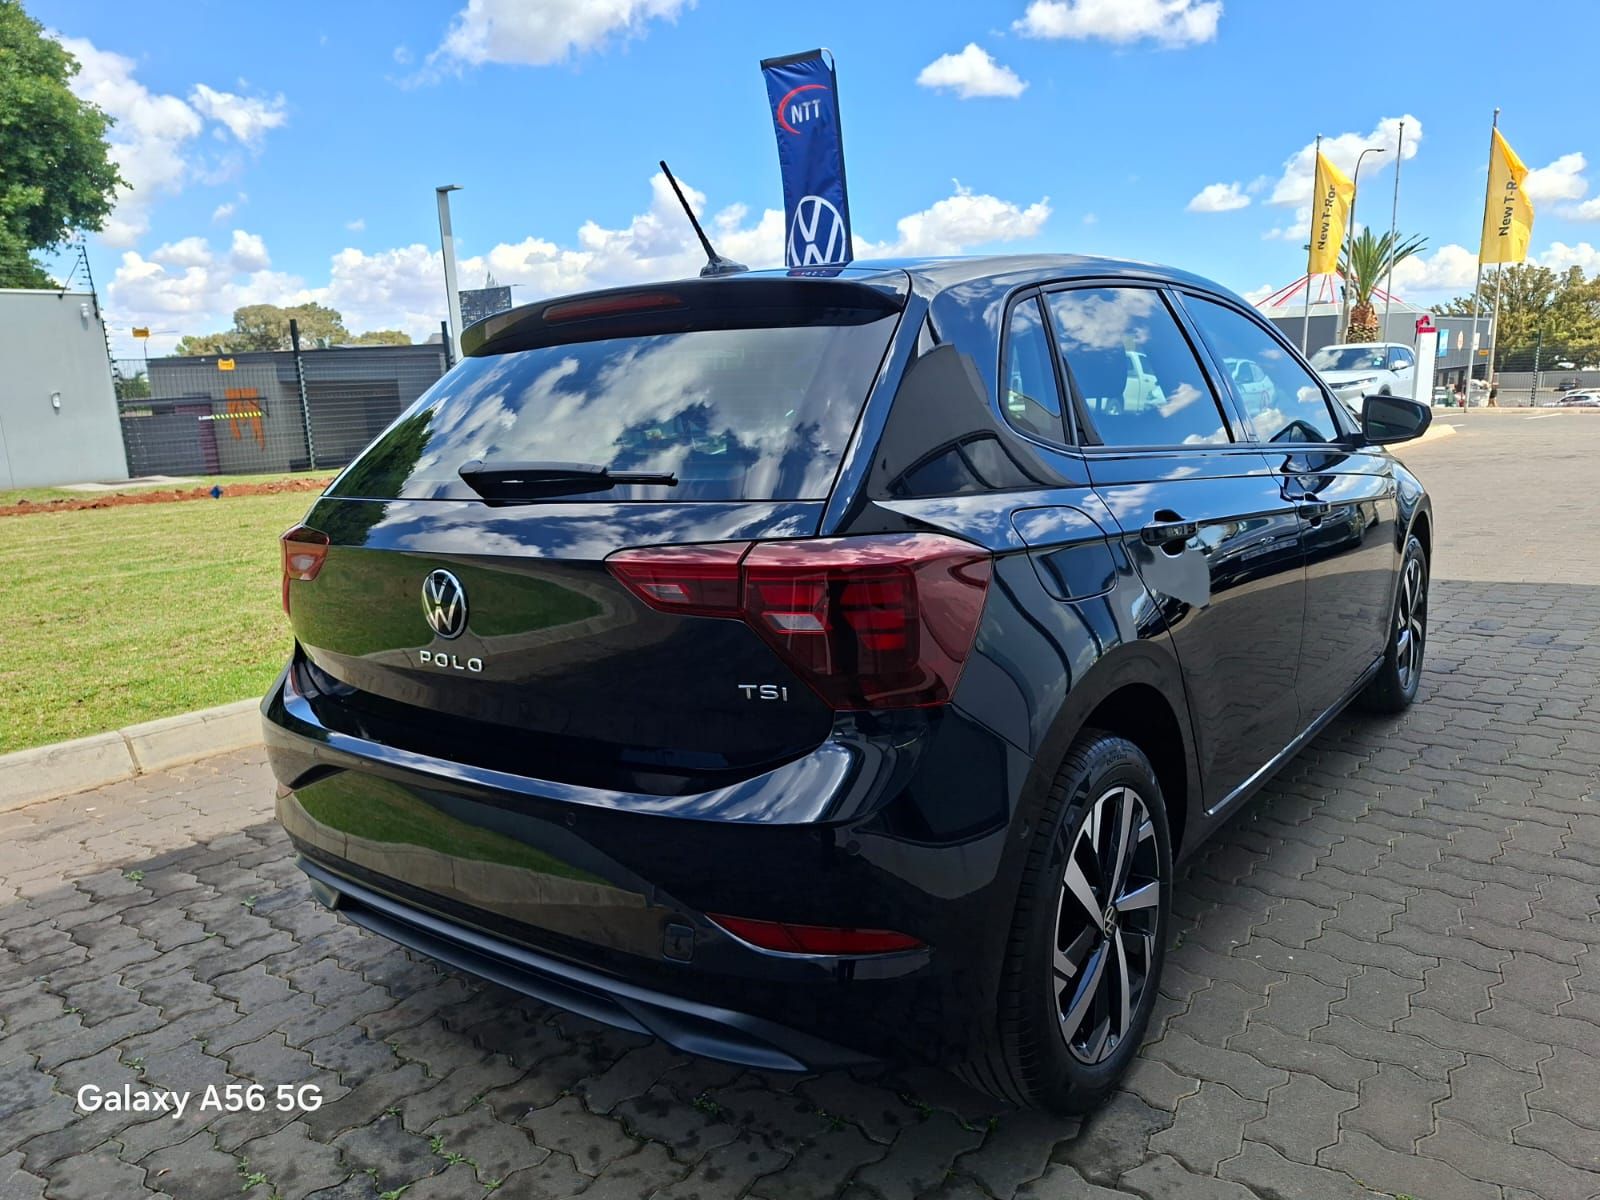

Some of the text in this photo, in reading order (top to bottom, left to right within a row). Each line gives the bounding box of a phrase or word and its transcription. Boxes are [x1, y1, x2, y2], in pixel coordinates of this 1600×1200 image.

[791, 99, 821, 124] NTT
[1499, 207, 1513, 236] New
[1318, 223, 1329, 250] New
[420, 650, 483, 672] POLO
[738, 684, 788, 702] TSI
